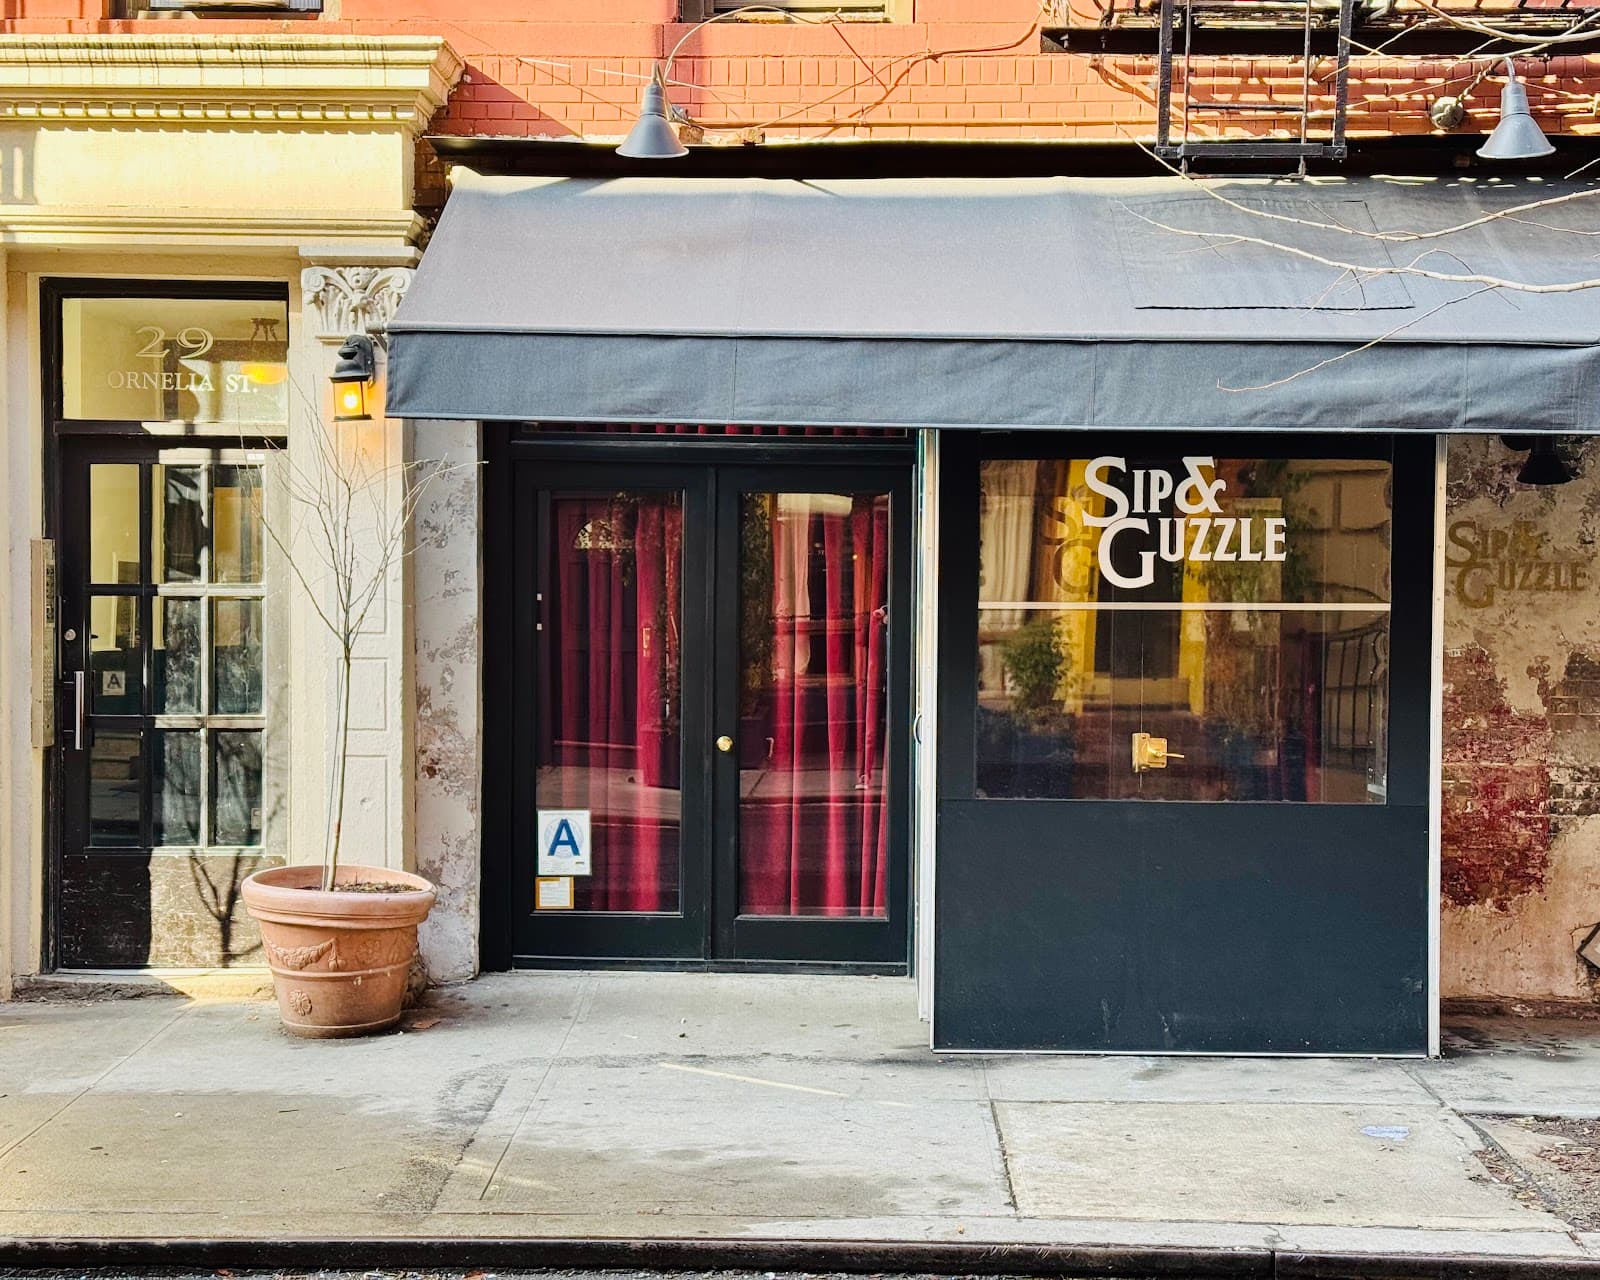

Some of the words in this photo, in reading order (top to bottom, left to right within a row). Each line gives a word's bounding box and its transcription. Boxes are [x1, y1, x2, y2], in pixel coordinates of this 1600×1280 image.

[136, 326, 214, 359] 29
[106, 371, 214, 392] ORNELIA
[1097, 517, 1287, 589] GUZZLE
[1456, 560, 1586, 609] GUZZLE
[547, 818, 580, 856] A
